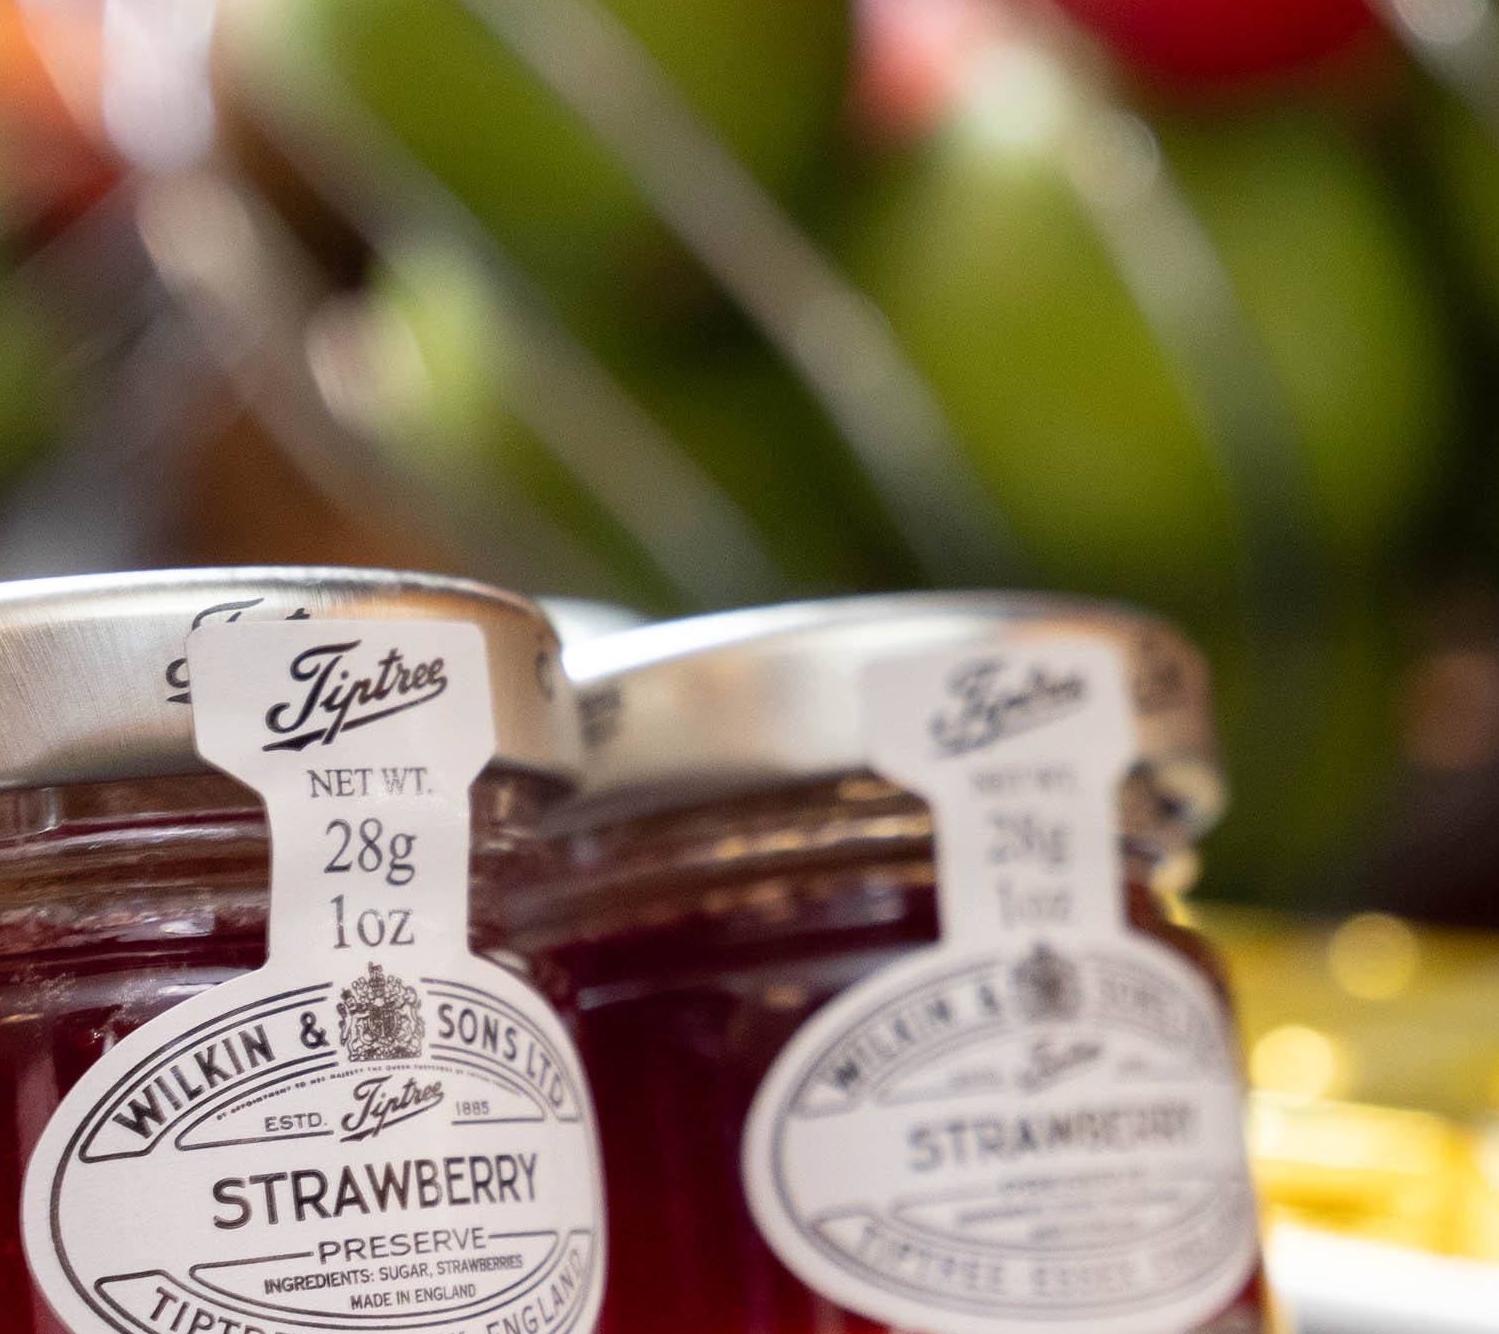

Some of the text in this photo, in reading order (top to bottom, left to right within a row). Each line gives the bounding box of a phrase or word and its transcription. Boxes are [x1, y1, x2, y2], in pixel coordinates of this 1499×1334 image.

[262, 639, 448, 752] Tiptree
[307, 767, 433, 798] NET WT.
[323, 818, 418, 886] 28g
[330, 894, 416, 950] 1oz
[112, 1023, 277, 1140] WILKIN
[300, 1010, 330, 1050] &
[438, 1003, 518, 1063] SONS
[526, 1042, 564, 1108] LTD
[265, 1112, 328, 1133] ESTD.
[340, 1074, 445, 1144] Tiptree
[455, 1101, 491, 1116] 1885
[906, 1099, 1193, 1174] STRAWBERRY
[212, 1153, 538, 1230] STRAWBERRY
[264, 1254, 523, 1296] INGREDIENTS: SUGAR, STRAWBERRIES
[318, 1227, 487, 1265] PRESERVE
[350, 1283, 477, 1311] MADE IN ENGLAND
